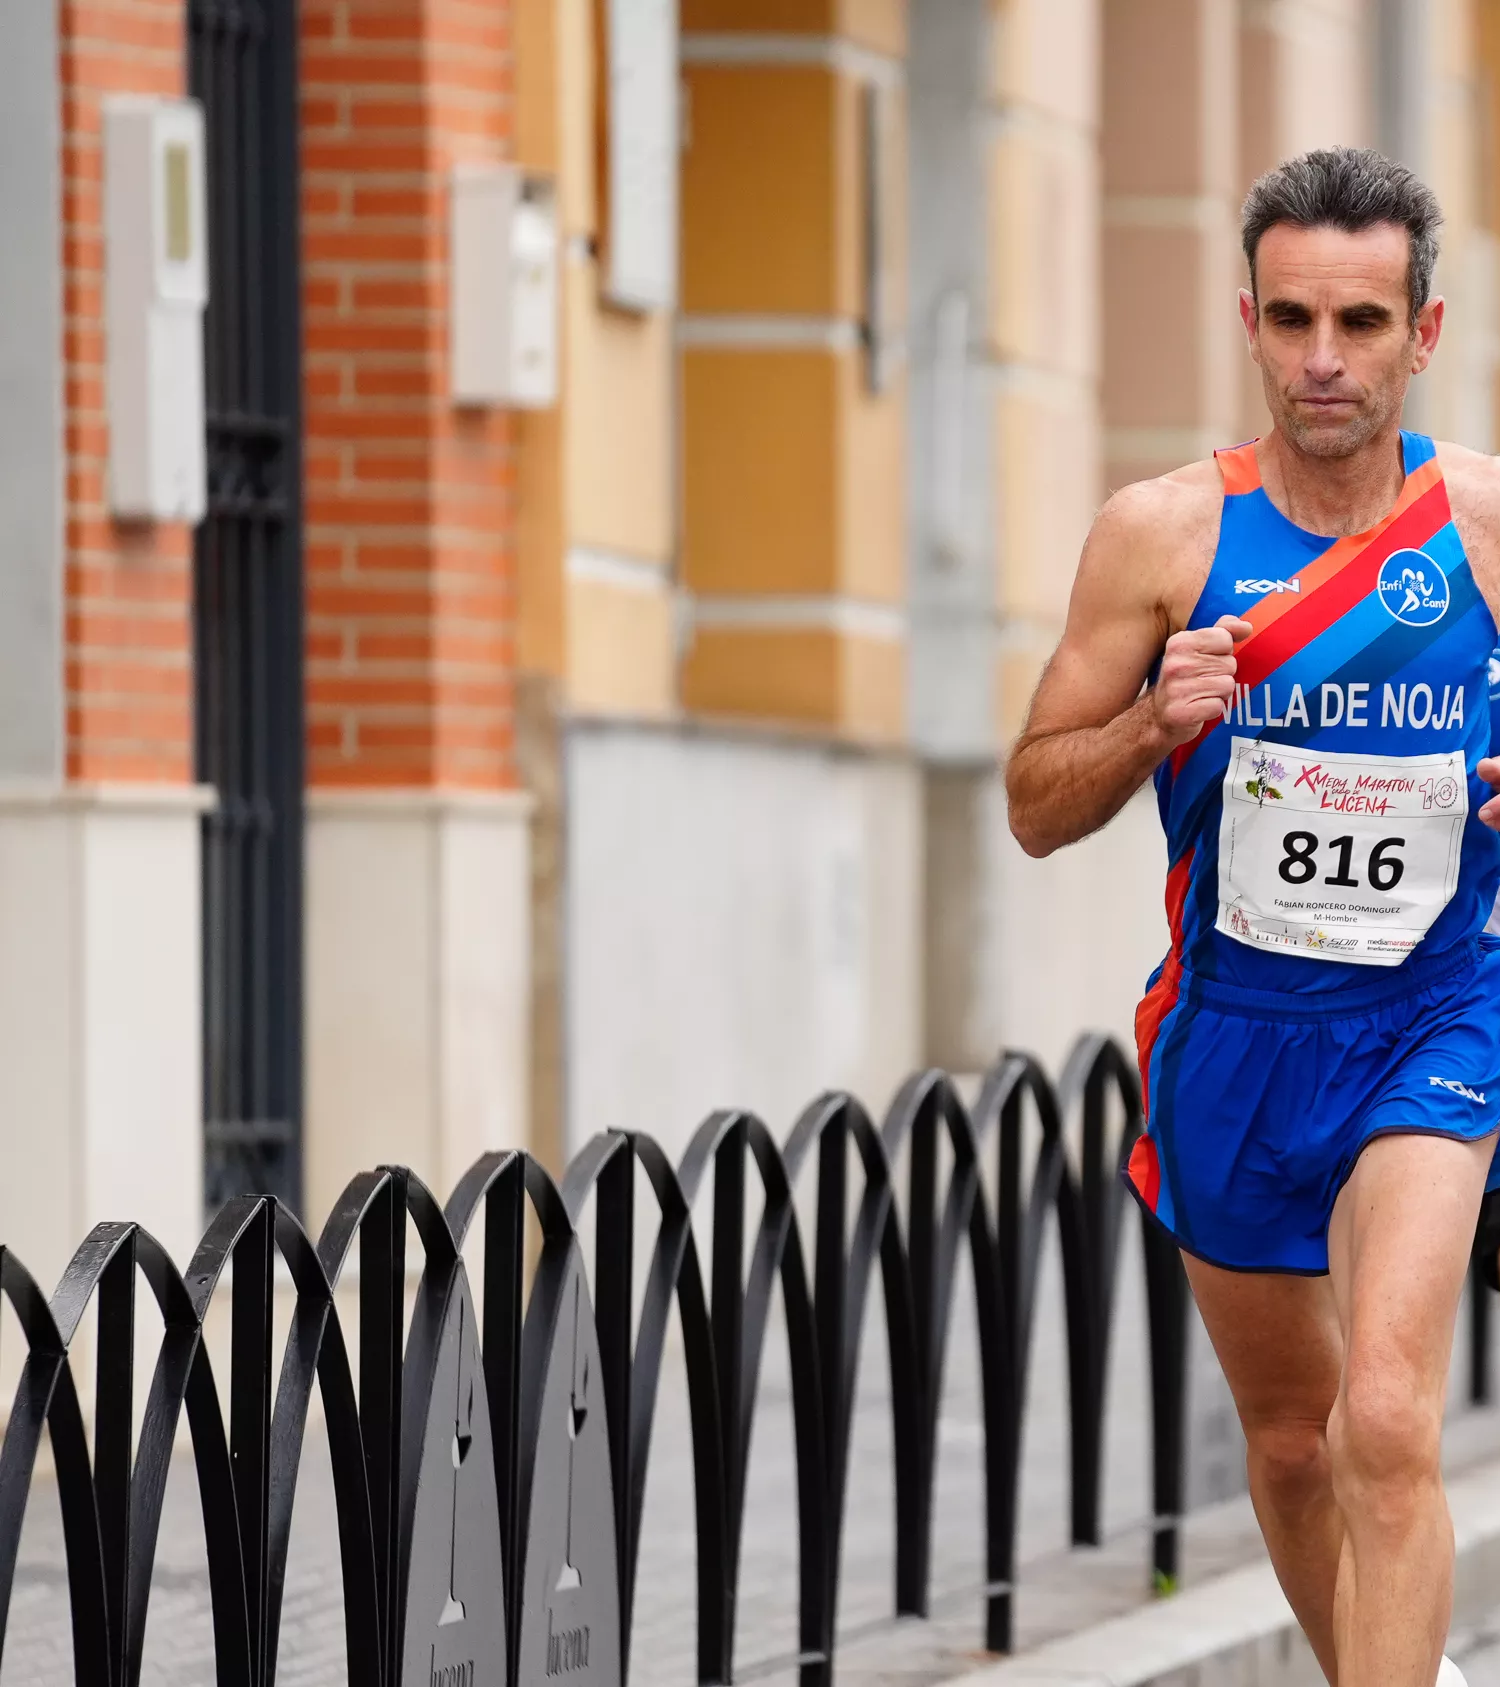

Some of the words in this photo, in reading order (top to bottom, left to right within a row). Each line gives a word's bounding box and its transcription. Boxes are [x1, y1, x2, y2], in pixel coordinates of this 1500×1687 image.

[1235, 578, 1300, 594] KON
[1381, 580, 1402, 591] Infi
[1422, 597, 1446, 608] Cant
[1320, 683, 1369, 728] DE
[1381, 683, 1465, 730] NOJA
[1294, 764, 1322, 795] X
[1320, 790, 1397, 816] LUCENA
[1278, 830, 1406, 891] 816
[1274, 899, 1304, 908] FABIAN
[1306, 902, 1346, 910] RONCERO
[1348, 905, 1401, 914] DOMINGUEZ
[1314, 914, 1358, 923] M-Hombre
